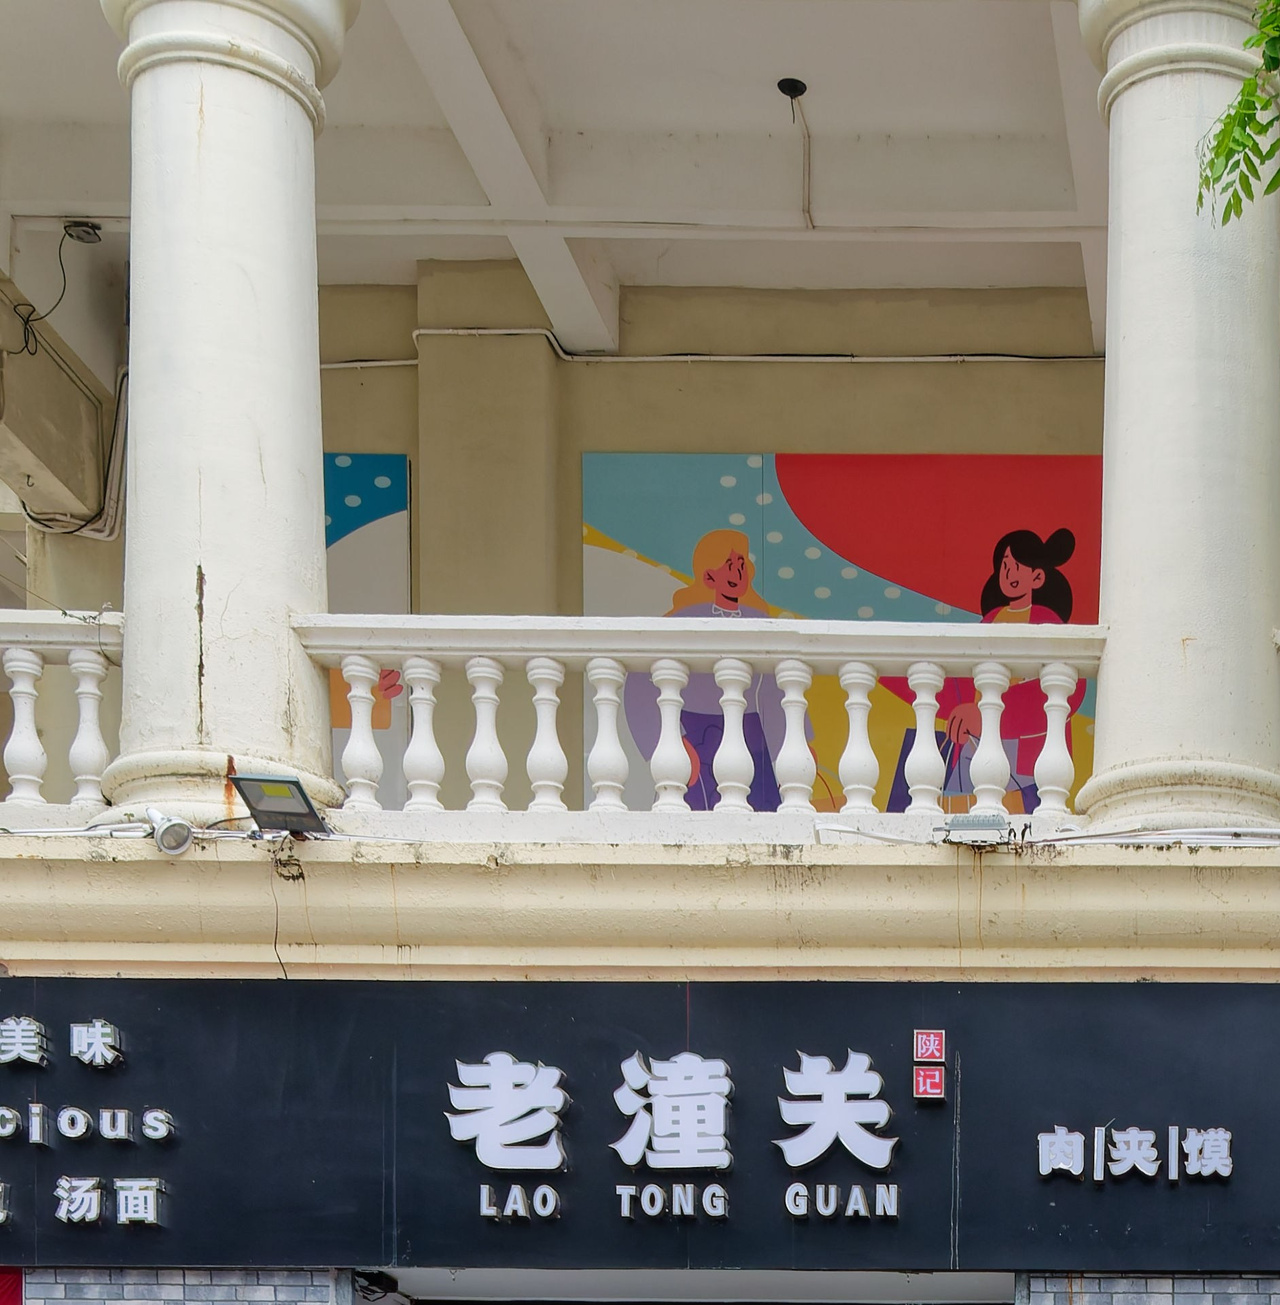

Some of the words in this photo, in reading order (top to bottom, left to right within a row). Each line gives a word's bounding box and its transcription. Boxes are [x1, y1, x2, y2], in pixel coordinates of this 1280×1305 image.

[915, 1031, 944, 1097] 陕记
[445, 1051, 899, 1171] 老潼关
[480, 1185, 558, 1218] LAO
[616, 1184, 729, 1218] TONG
[786, 1183, 899, 1217] GUAN
